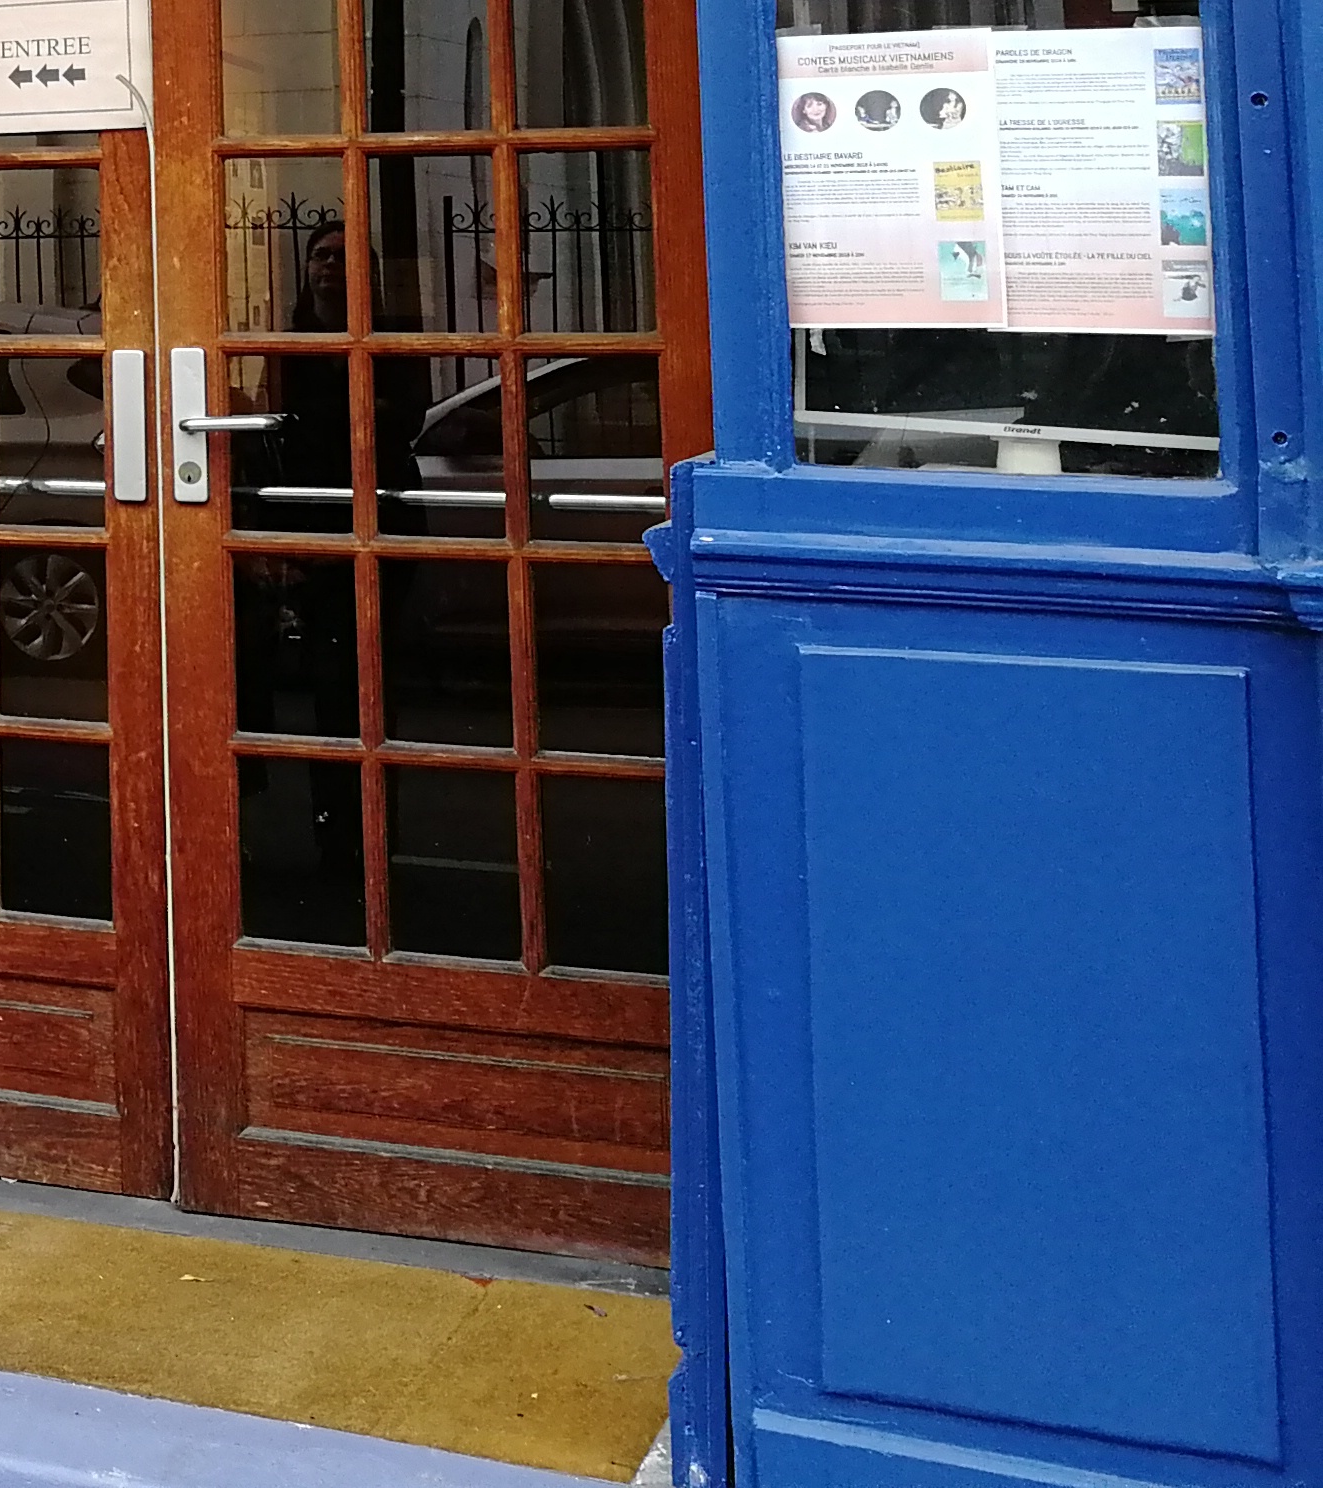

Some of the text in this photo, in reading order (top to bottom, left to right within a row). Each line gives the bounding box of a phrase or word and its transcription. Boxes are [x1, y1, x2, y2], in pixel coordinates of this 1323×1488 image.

[0, 36, 92, 59] ENTREE
[867, 43, 882, 51] POUR
[995, 49, 1029, 57] PAROLES
[1042, 48, 1073, 56] DRAGON
[797, 51, 954, 66] CONTES MUSICAUX VIETNAMIENS
[818, 65, 839, 73] Carte
[840, 64, 870, 72] blanche
[879, 63, 907, 71] Isabelle
[911, 62, 934, 70] Genlis
[1009, 118, 1035, 126] TRESSE
[1048, 118, 1085, 126] L'OGRESSE
[783, 152, 863, 161] LE BESTIAIRE BAVARD
[803, 242, 817, 250] VAN
[1004, 252, 1022, 260] SOUS
[1032, 251, 1053, 260] VOÛTE
[1054, 251, 1082, 260] ÉTOILÉE
[1137, 252, 1152, 260] CIEL
